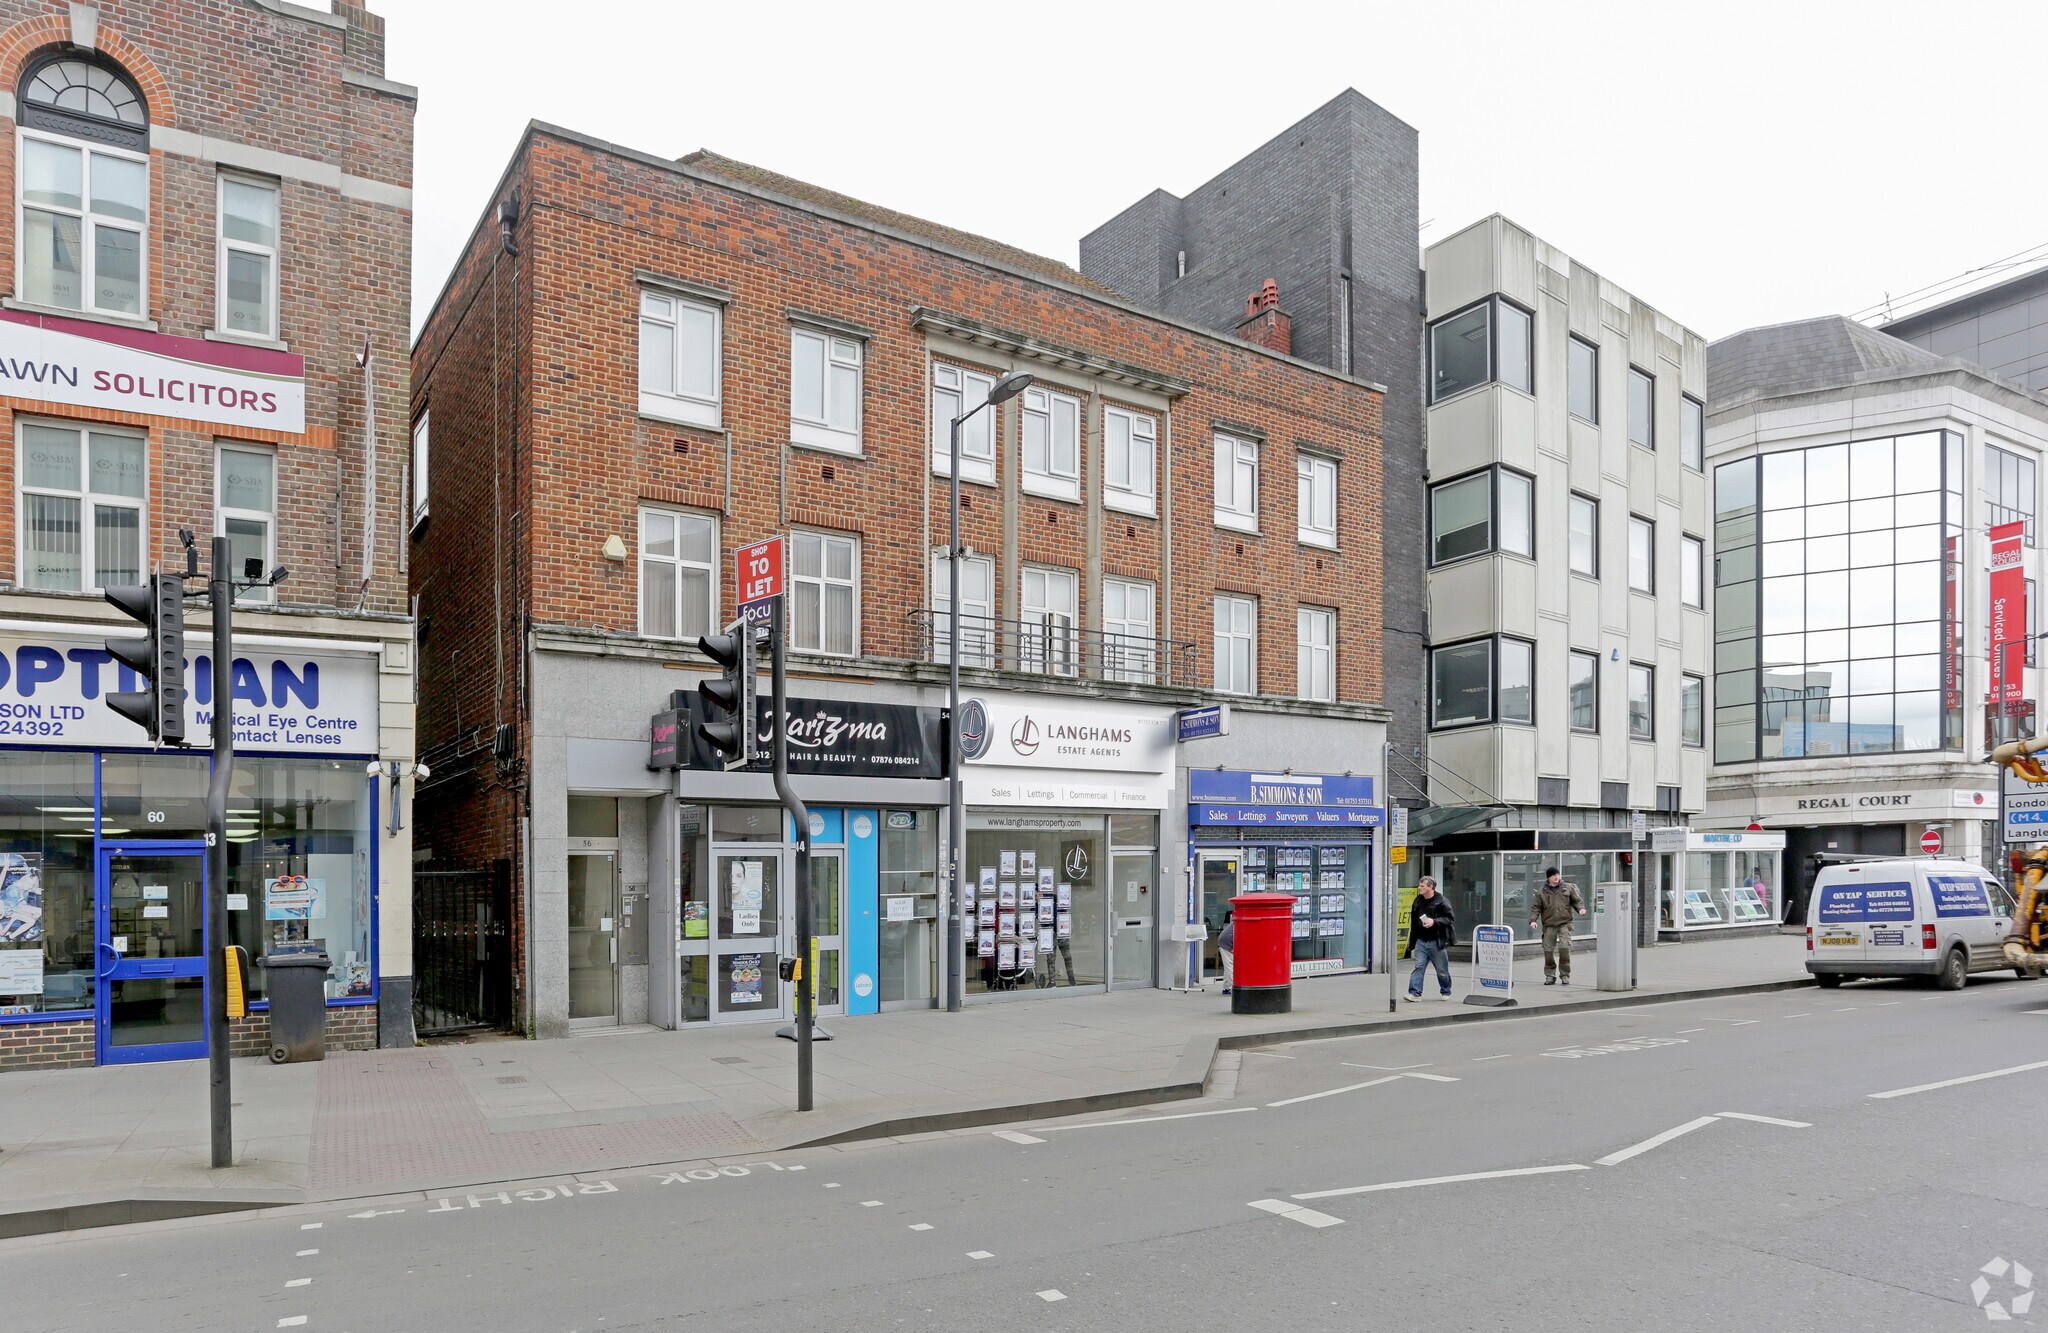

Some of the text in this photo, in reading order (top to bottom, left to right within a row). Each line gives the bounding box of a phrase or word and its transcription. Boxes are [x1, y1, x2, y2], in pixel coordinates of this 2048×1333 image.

[94, 370, 278, 413] SOLICITORS
[751, 545, 768, 557] SHOP
[1992, 549, 2021, 561] REGAL
[749, 557, 769, 577] TO
[1992, 555, 2021, 567] COURT
[746, 576, 773, 599] LET
[1994, 598, 2006, 641] Serviced
[50, 705, 85, 720] LTD
[195, 711, 358, 730] Mical Eye Centre
[231, 729, 342, 745] ontact Lenses
[1047, 724, 1132, 743] LANGHAMS
[789, 752, 812, 760] HAIR
[823, 754, 857, 763] BEAUTY
[870, 755, 893, 764] 07876
[893, 756, 920, 766] 084214
[1057, 746, 1121, 757] ESTATE AGENTS
[991, 787, 1147, 802] Sales Lettings Commercial Finance
[1298, 787, 1305, 805] &
[1306, 787, 1323, 805] SON
[1797, 794, 1911, 810] REGAL COURT
[147, 811, 165, 823] 60
[987, 817, 1082, 829] www.langhamsproperty.com
[1209, 810, 1380, 824] Sales Lettings Surveyors Valuers Mortgages
[1845, 891, 1863, 899] TAP
[1866, 889, 1907, 899] SERVICES
[1309, 961, 1342, 971] LETTINGS
[653, 1161, 785, 1185] LOOK
[427, 1179, 620, 1214] RIGHT
